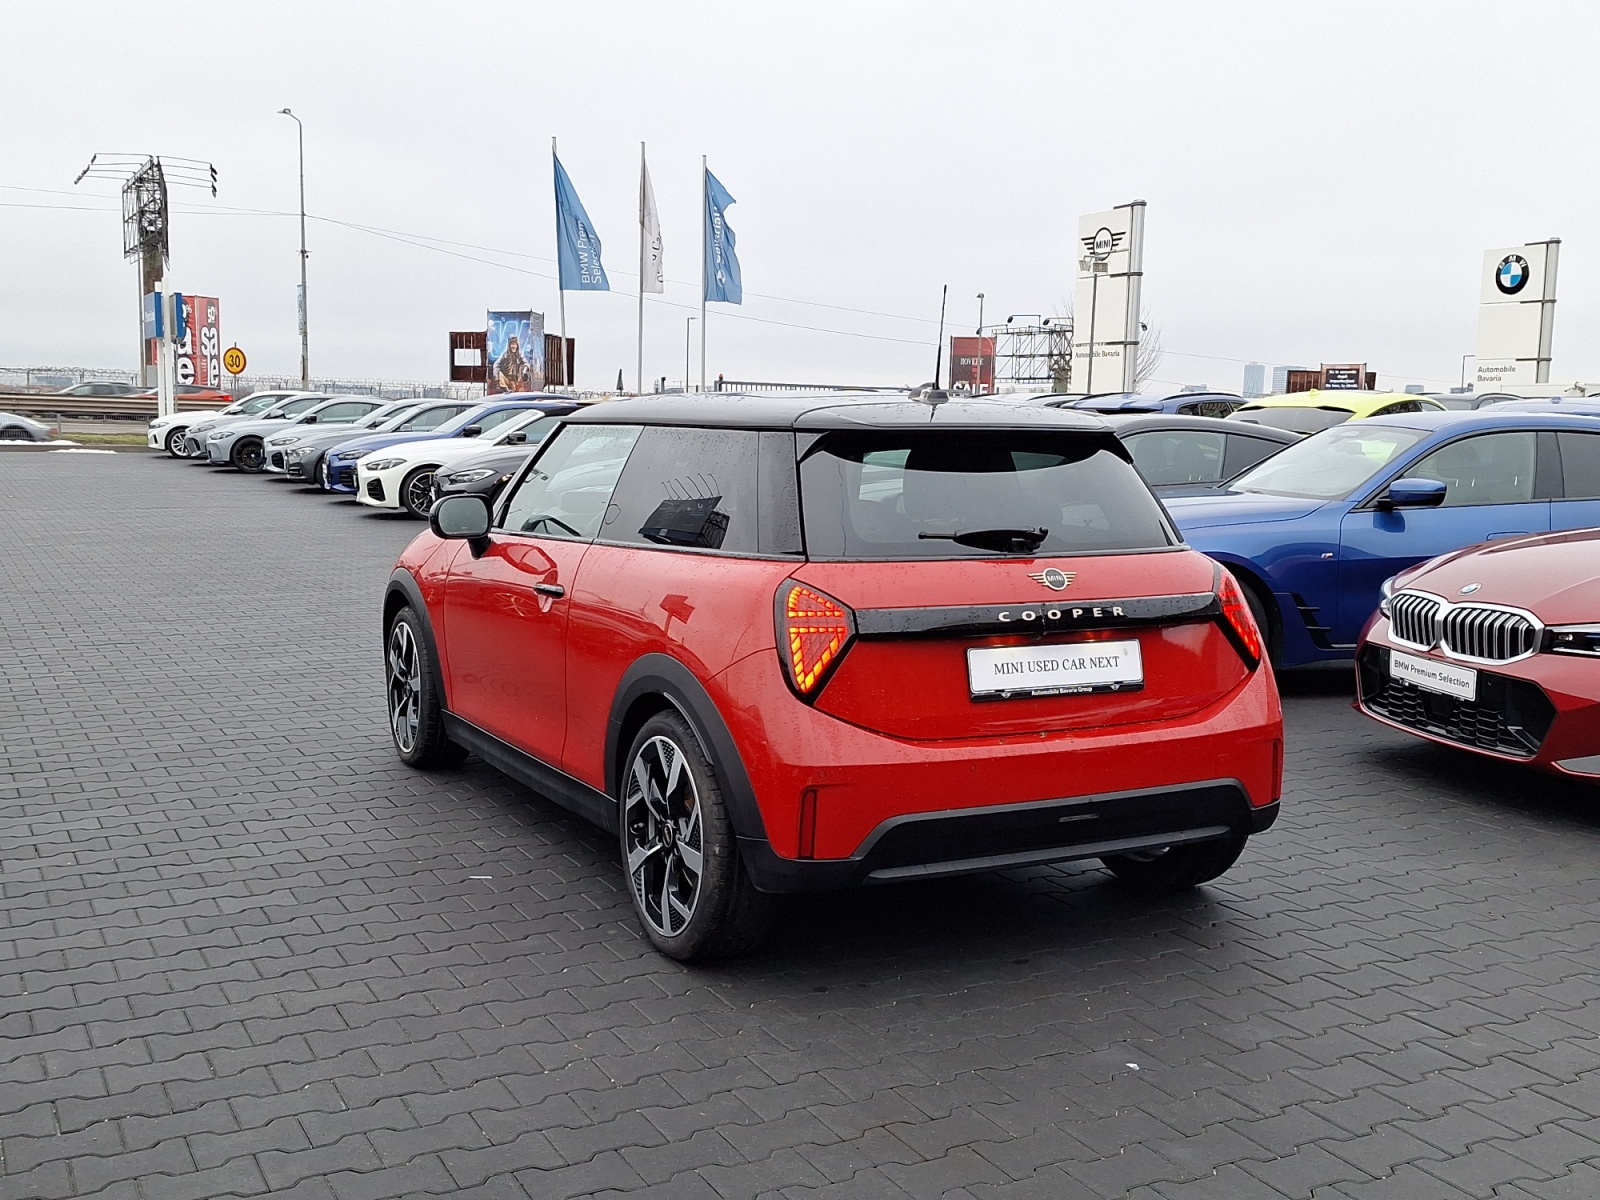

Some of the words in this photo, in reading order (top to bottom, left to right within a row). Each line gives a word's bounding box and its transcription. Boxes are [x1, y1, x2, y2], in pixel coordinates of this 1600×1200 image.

[1095, 239, 1110, 250] MINI
[578, 252, 590, 283] BMW
[229, 354, 241, 368] 30
[998, 606, 1125, 622] COOPER
[994, 662, 1024, 675] MINI
[1027, 659, 1059, 672] USED
[1062, 657, 1086, 670] CAR
[1089, 656, 1120, 668] NEXT
[1394, 659, 1410, 671] BMW
[1410, 664, 1437, 679] Premium
[1438, 672, 1470, 688] Selection
[1031, 688, 1059, 696] Automobile
